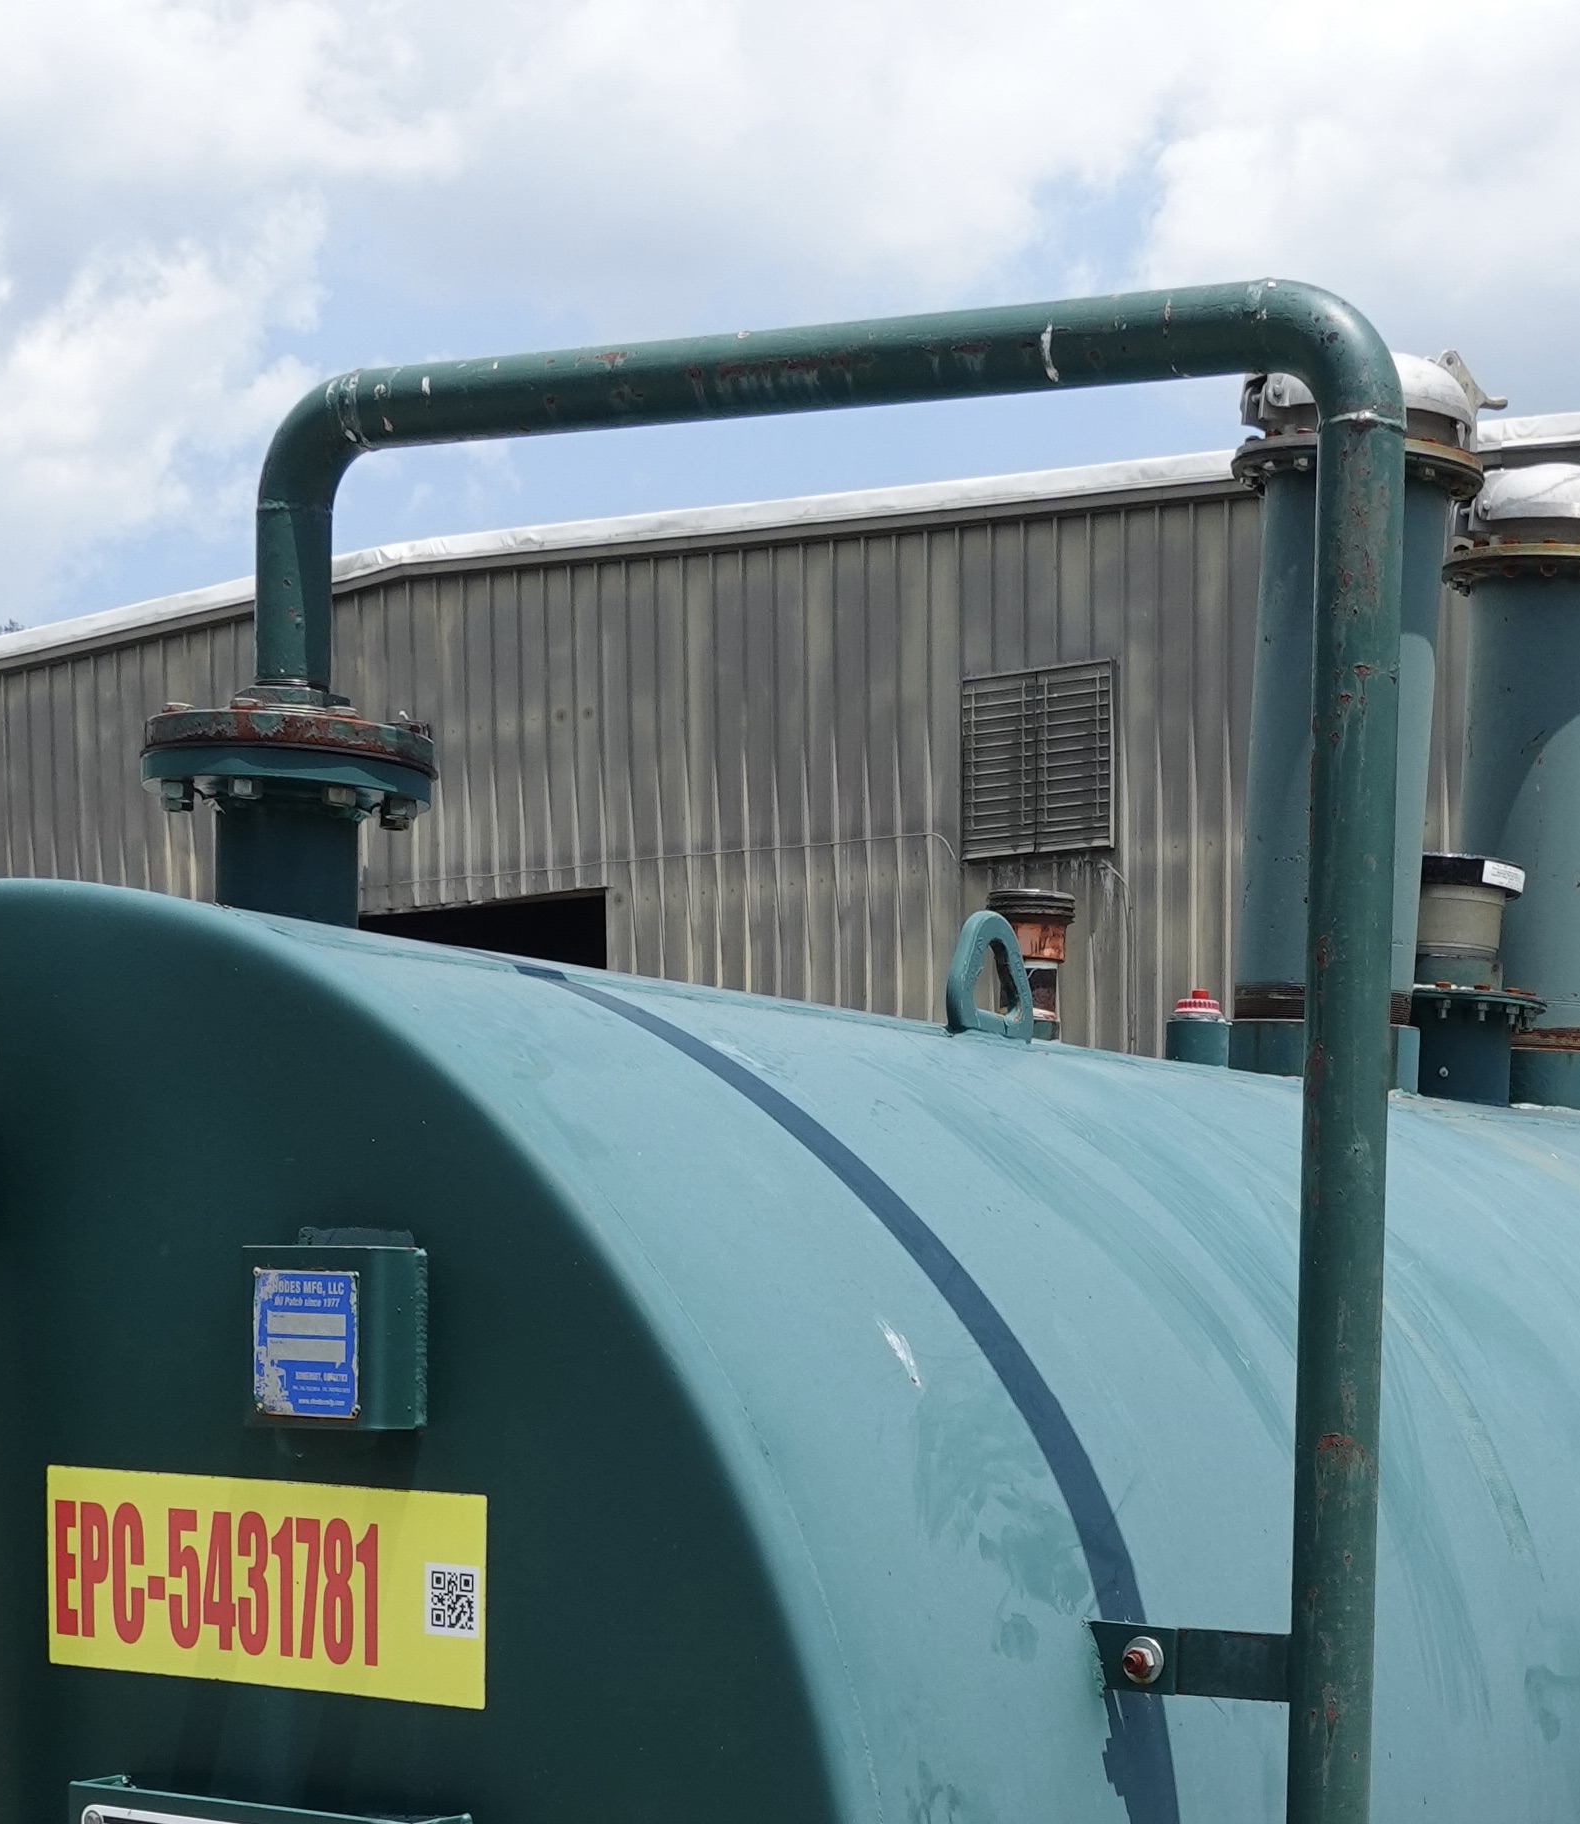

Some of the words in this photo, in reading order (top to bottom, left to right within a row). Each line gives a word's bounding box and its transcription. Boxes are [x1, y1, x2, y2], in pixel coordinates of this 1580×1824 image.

[303, 1280, 326, 1297] MFG,
[328, 1281, 345, 1296] LLC
[54, 1498, 379, 1667] EPC-5431781
